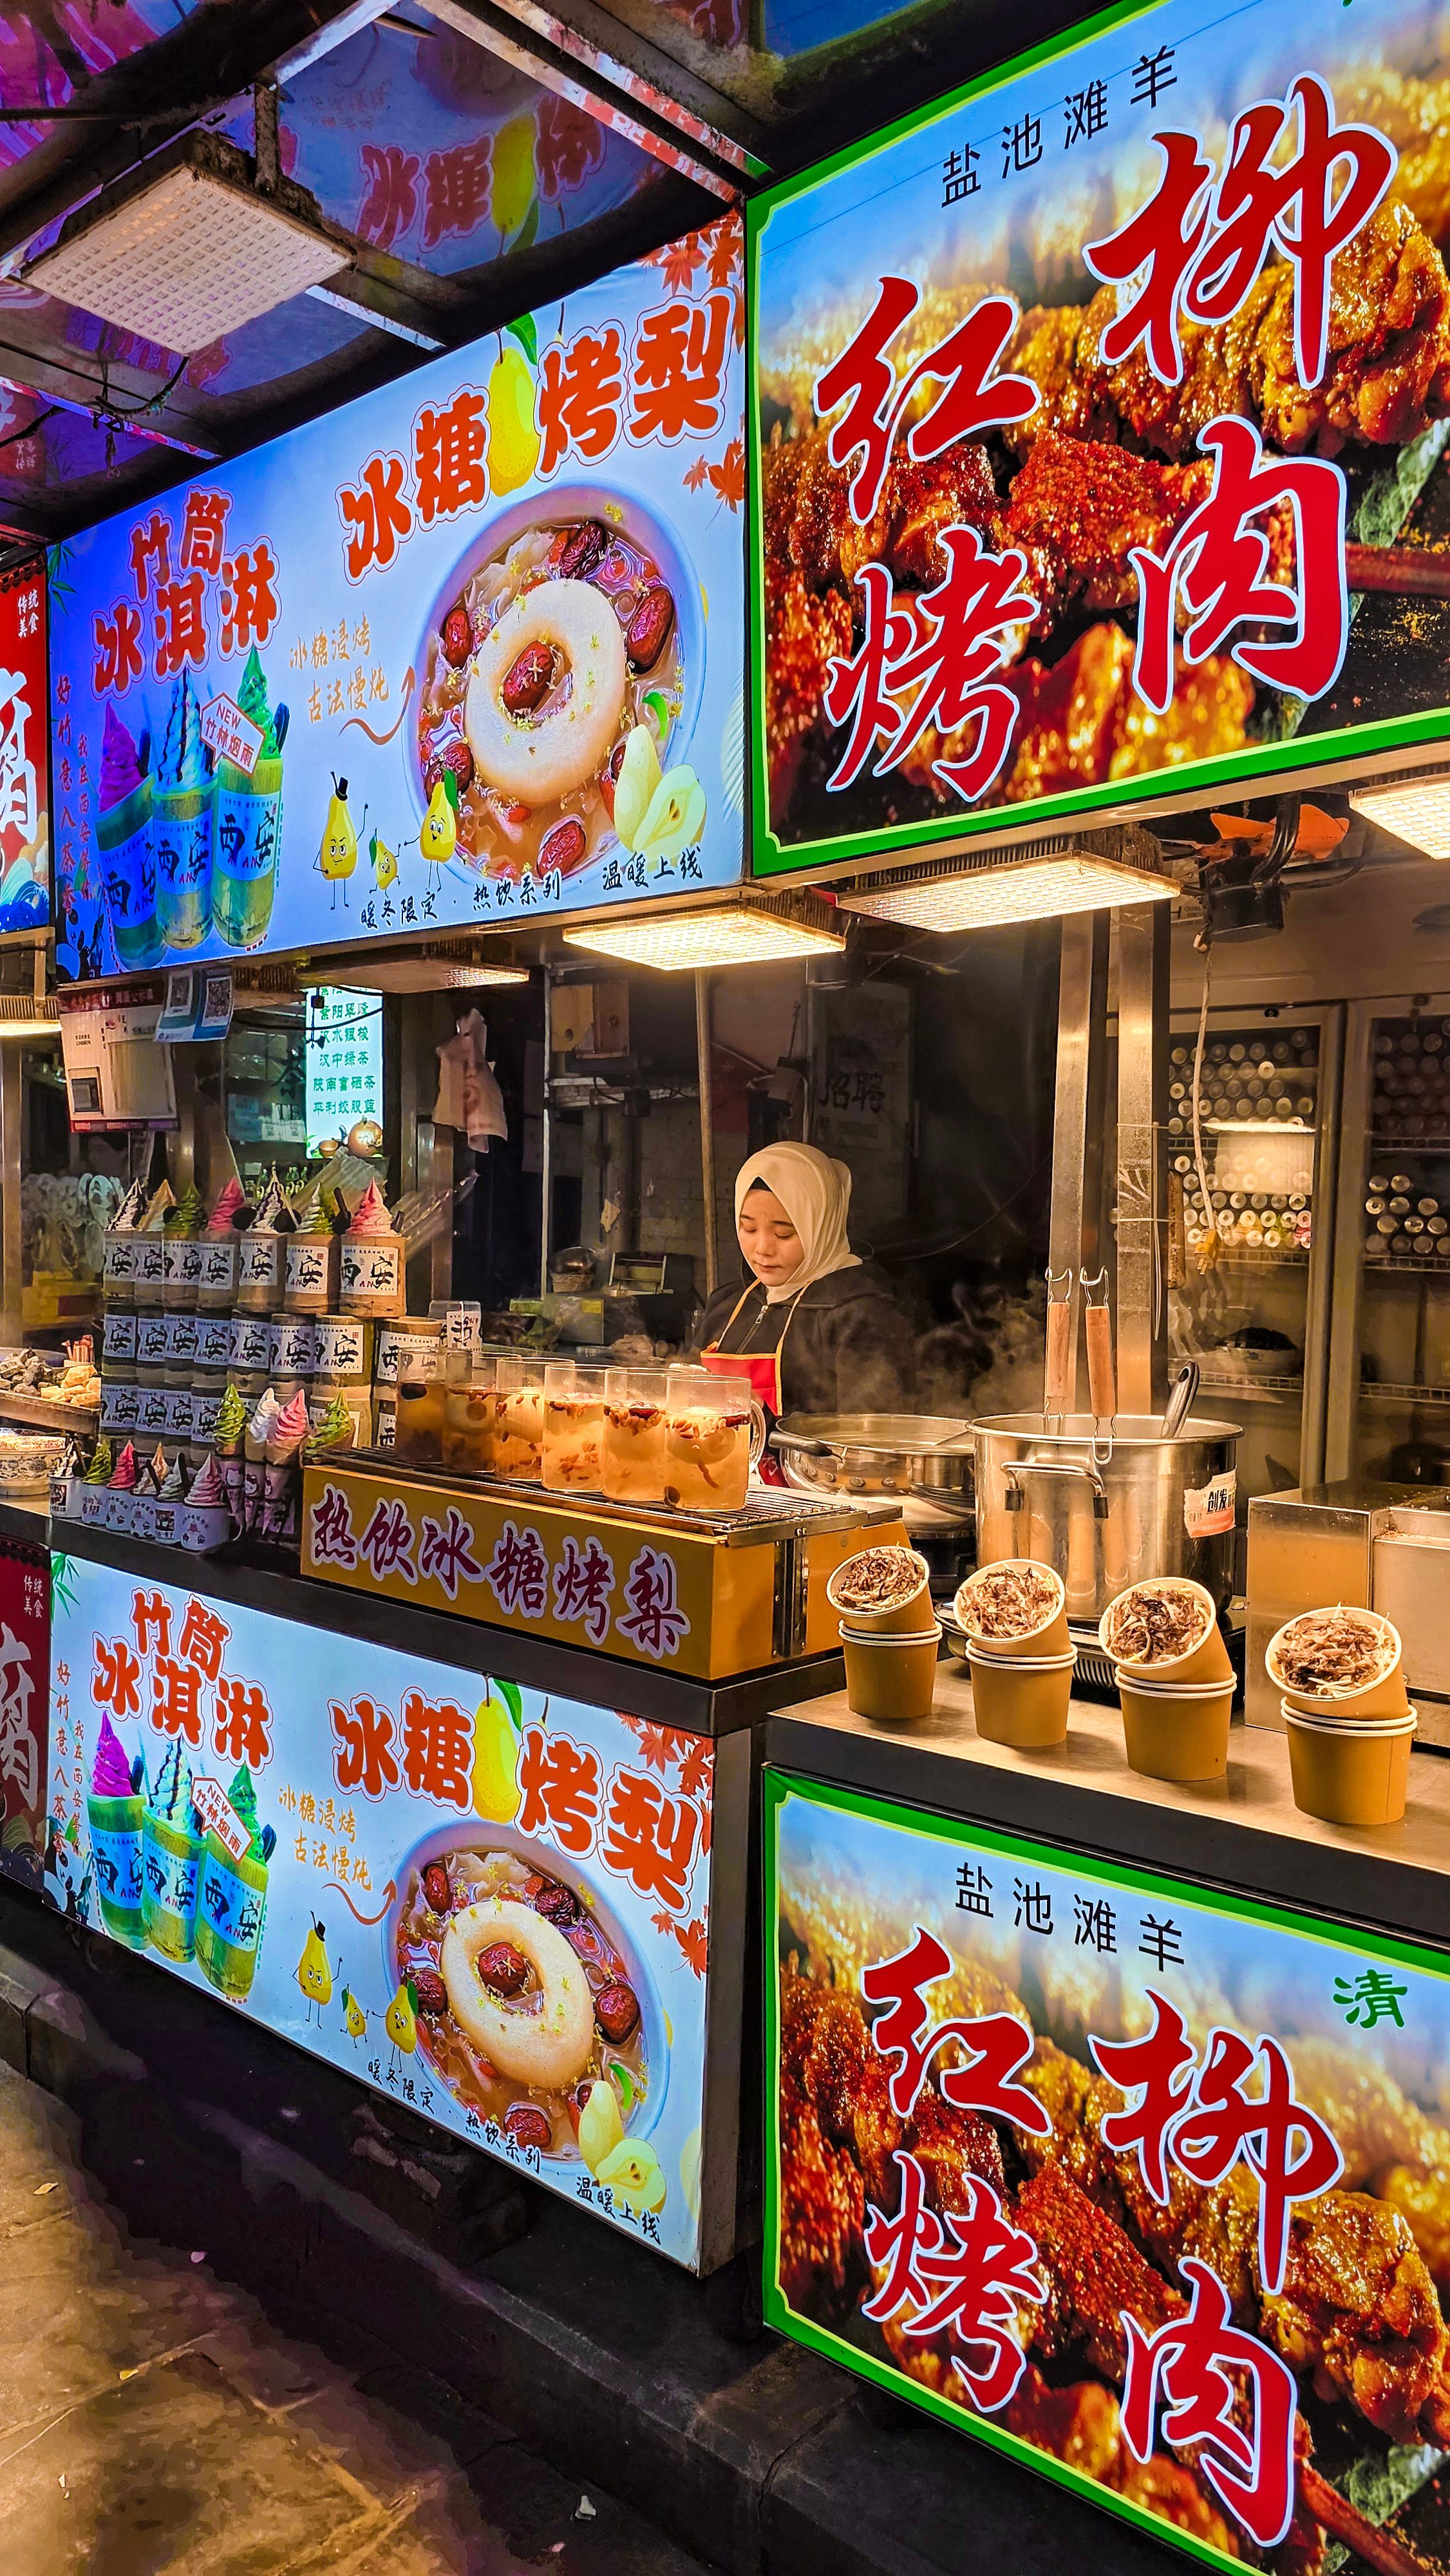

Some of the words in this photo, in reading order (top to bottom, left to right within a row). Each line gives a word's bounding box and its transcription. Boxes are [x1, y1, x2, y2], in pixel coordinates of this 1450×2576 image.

[941, 44, 1177, 208] 盐池滩羊
[341, 294, 730, 576] 冰糖烤梨
[131, 489, 227, 599] 竹筒
[17, 589, 39, 616] 传统
[17, 612, 39, 638] 美食
[95, 543, 277, 693] 冰淇淋
[290, 612, 371, 670] 冰糖浸烤
[216, 703, 241, 730] NEW
[306, 662, 390, 724] 古法慢炖
[205, 716, 254, 767] 竹林烟雨
[220, 811, 275, 869] 西安
[361, 887, 438, 929] 暖冬限定
[473, 868, 561, 912] 热饮系列
[602, 846, 703, 891] 温暖上线
[313, 1075, 376, 1092] 陕南富硒茶
[319, 1051, 369, 1068] 汉中绿茶
[24, 1575, 43, 1598] 传统
[313, 1489, 686, 1650] 热饮冰糖烤梨
[23, 1596, 43, 1618] 美食
[133, 1591, 229, 1680] 竹筒
[95, 1638, 269, 1767] 冰淇淋
[196, 1789, 241, 1854] 竹林烟雨
[207, 1785, 231, 1816] NEW
[279, 1784, 355, 1843] 冰糖浸烤
[334, 1694, 698, 1910] 冰糖烤梨
[146, 1855, 194, 1911] 西安
[294, 1835, 372, 1891] 古法慢炖
[205, 1875, 257, 1942] 西安
[955, 1862, 1185, 1972] 盐池滩羊
[1333, 1969, 1408, 2029] 清
[368, 2060, 435, 2116] 暖冬限定
[466, 2110, 541, 2174] 热饮系列
[576, 2177, 662, 2246] 温暖上线
